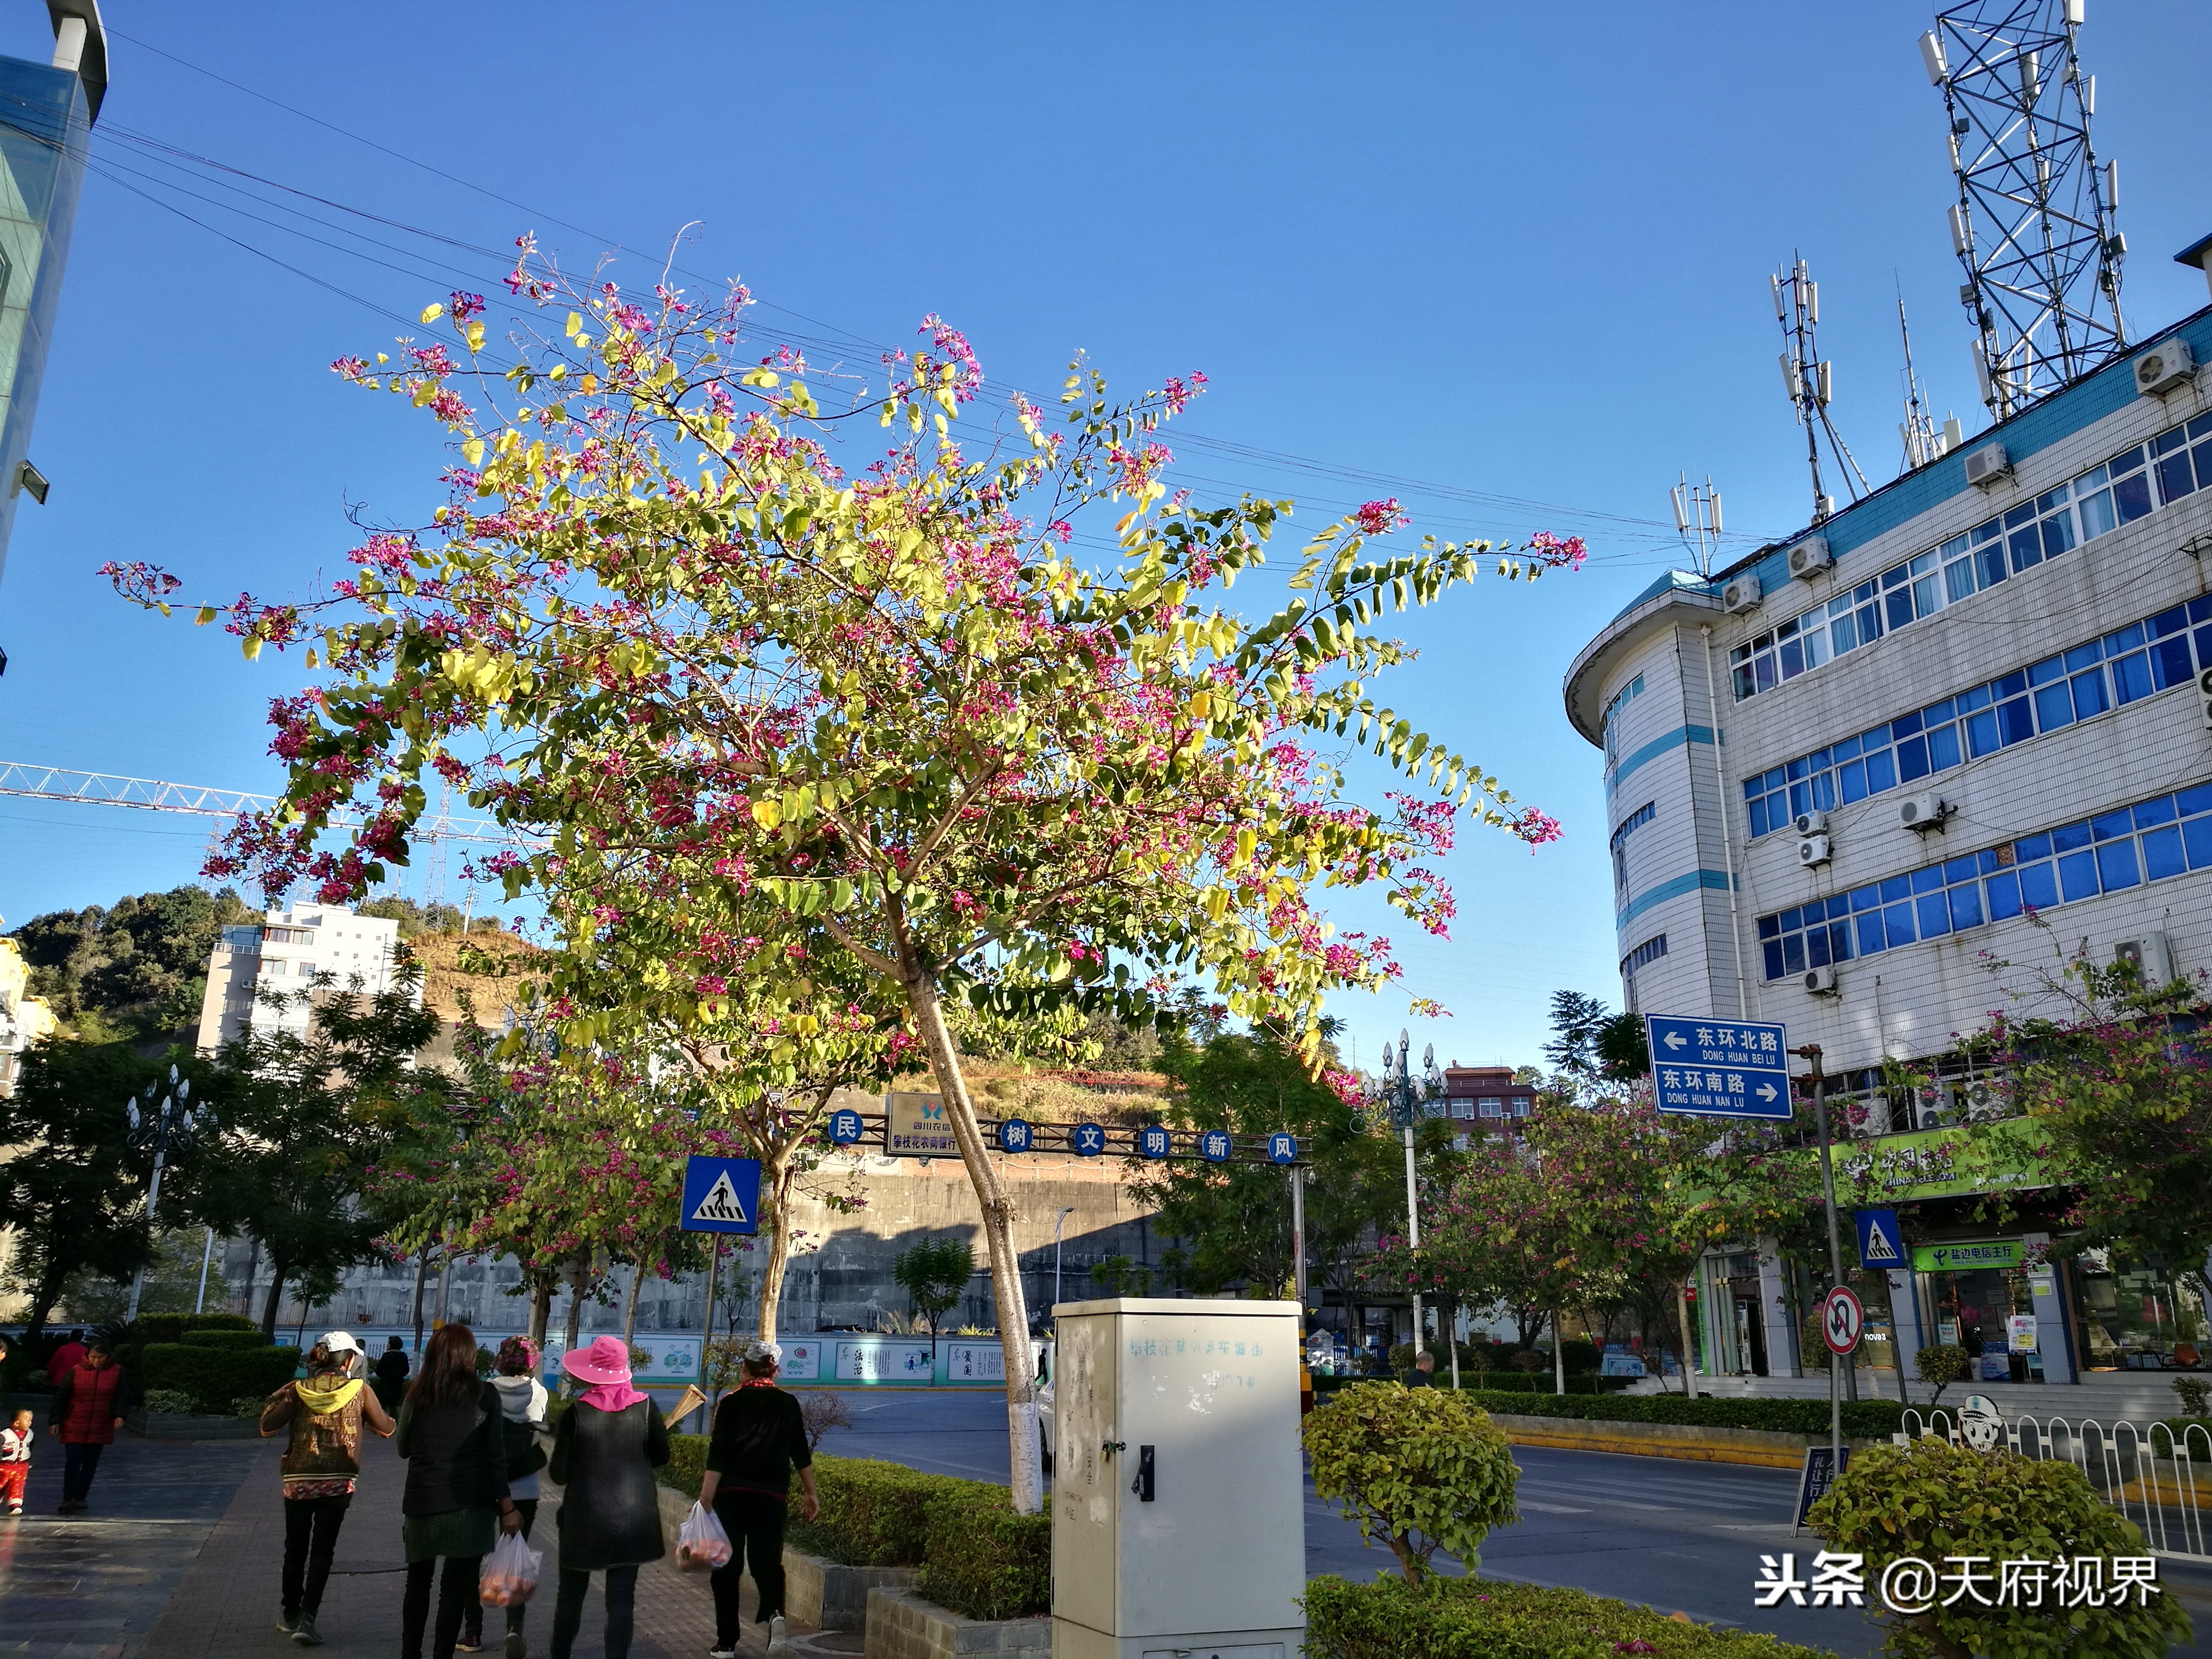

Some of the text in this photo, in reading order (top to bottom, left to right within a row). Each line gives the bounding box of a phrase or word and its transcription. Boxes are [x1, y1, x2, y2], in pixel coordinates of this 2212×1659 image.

[1696, 1026, 1778, 1052] 东环北路
[1702, 1049, 1776, 1065] DONG HUAN BEI LU
[1662, 1069, 1745, 1094] 东环南路
[1667, 1092, 1744, 1108] DONG HUAN NAN LU
[913, 1122, 950, 1131] 四川农信
[837, 1115, 1292, 1158] 民 树 文 明 新 风
[1885, 1177, 1911, 1186] CHINA
[1951, 1245, 2012, 1260] 盐边电信主厅
[853, 1349, 864, 1376] 法治
